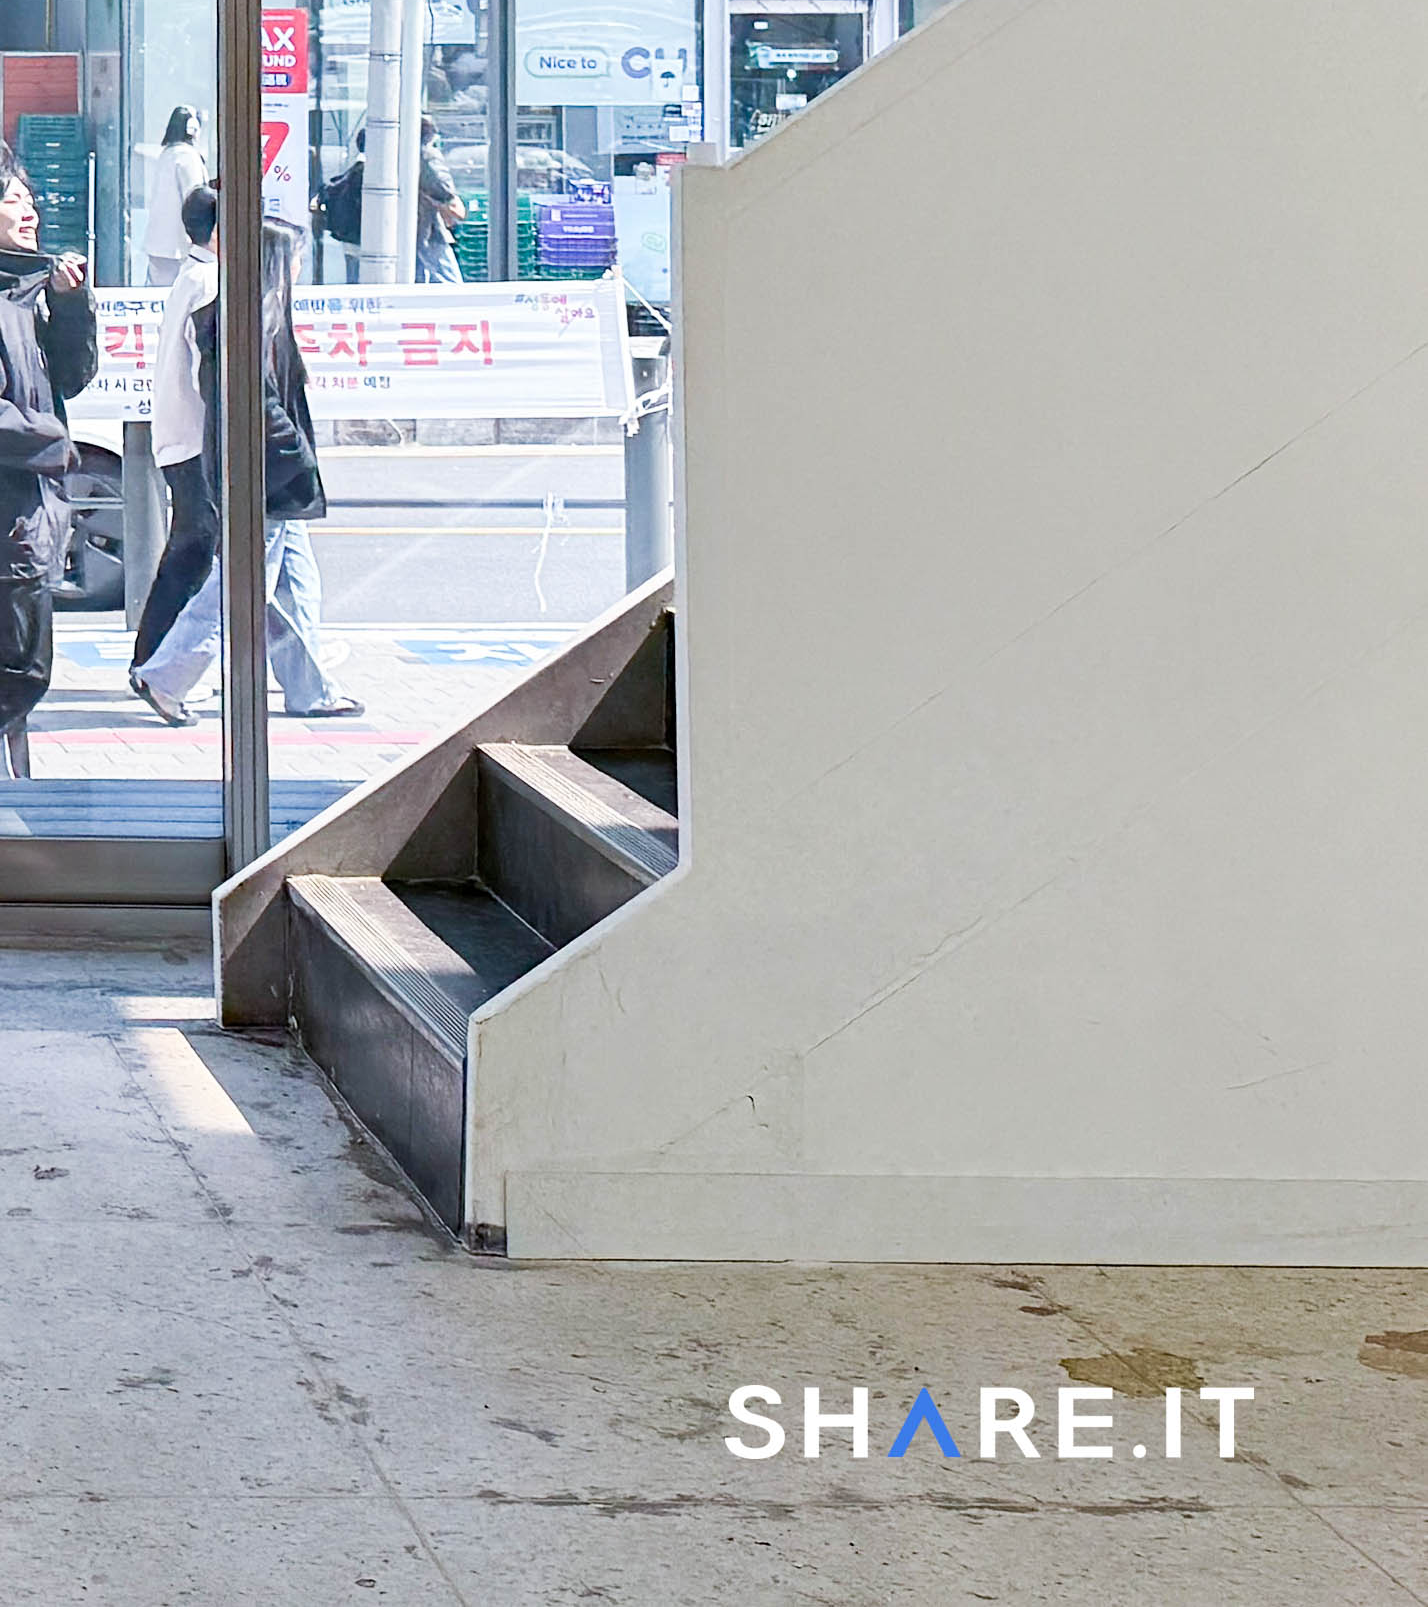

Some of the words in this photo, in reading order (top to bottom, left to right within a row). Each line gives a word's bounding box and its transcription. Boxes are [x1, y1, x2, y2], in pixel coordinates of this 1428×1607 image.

[262, 54, 297, 68] UND
[540, 55, 577, 69] Nice
[581, 56, 598, 69] to
[105, 324, 146, 369] 킥
[397, 320, 493, 367] 금지
